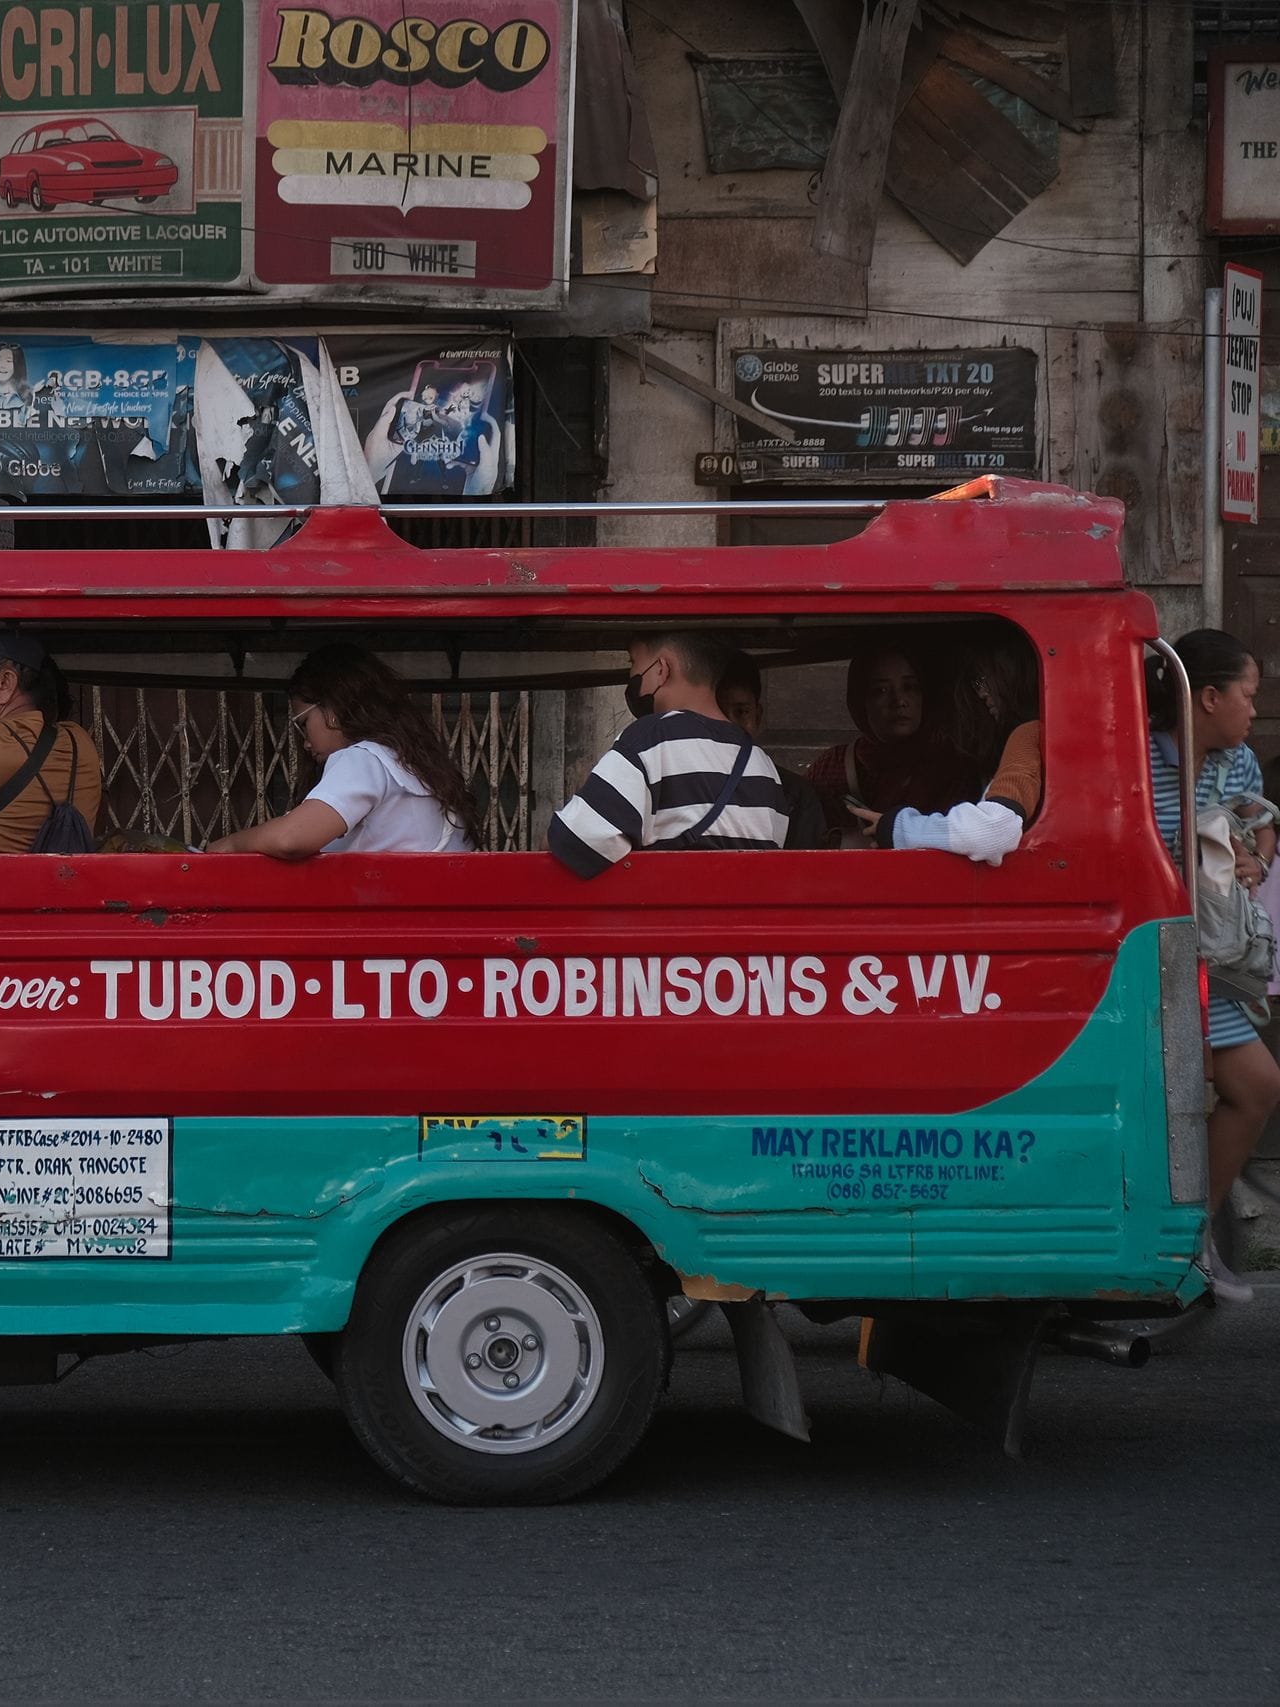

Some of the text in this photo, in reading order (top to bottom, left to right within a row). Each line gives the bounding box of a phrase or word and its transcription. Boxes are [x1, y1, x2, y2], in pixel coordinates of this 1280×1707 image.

[268, 8, 550, 88] ROSCO
[1236, 64, 1280, 96] We
[1240, 141, 1278, 159] THE
[325, 152, 492, 179] MARINE
[33, 226, 141, 245] AUTOMOTIVE
[145, 224, 228, 243] LACQUER
[62, 255, 91, 274] 101
[107, 254, 163, 273] WHITE
[352, 242, 459, 273] 500 WHITE
[1232, 282, 1256, 325] (PUJ)
[1226, 332, 1258, 373] JEEPNEY
[762, 374, 800, 382] PREPAID
[763, 361, 799, 373] Globe
[926, 362, 962, 384] TXT
[967, 362, 993, 384] 20
[819, 387, 837, 396] 200
[838, 387, 862, 396] texts
[864, 387, 873, 396] to
[874, 387, 886, 396] all
[955, 387, 971, 397] per
[973, 386, 994, 397] day.
[1231, 379, 1252, 416] STOP
[972, 425, 983, 433] Go
[983, 425, 1000, 434] lang
[1001, 426, 1011, 434] ng
[803, 438, 826, 447] 8888
[1236, 430, 1247, 462] NO
[8, 459, 62, 477] Globe
[964, 453, 987, 467] TXT
[989, 453, 1005, 467] 20
[1227, 469, 1255, 503] PARKING
[841, 954, 899, 1016] &
[751, 1127, 1037, 1164] MAY REKLAMO KA?
[35, 1157, 73, 1176] ORAK
[78, 1156, 147, 1175] TANGOTE
[791, 1163, 1006, 1181] ITAWAG SA LTFRB HOTLINE:
[826, 1178, 866, 1200] (088)
